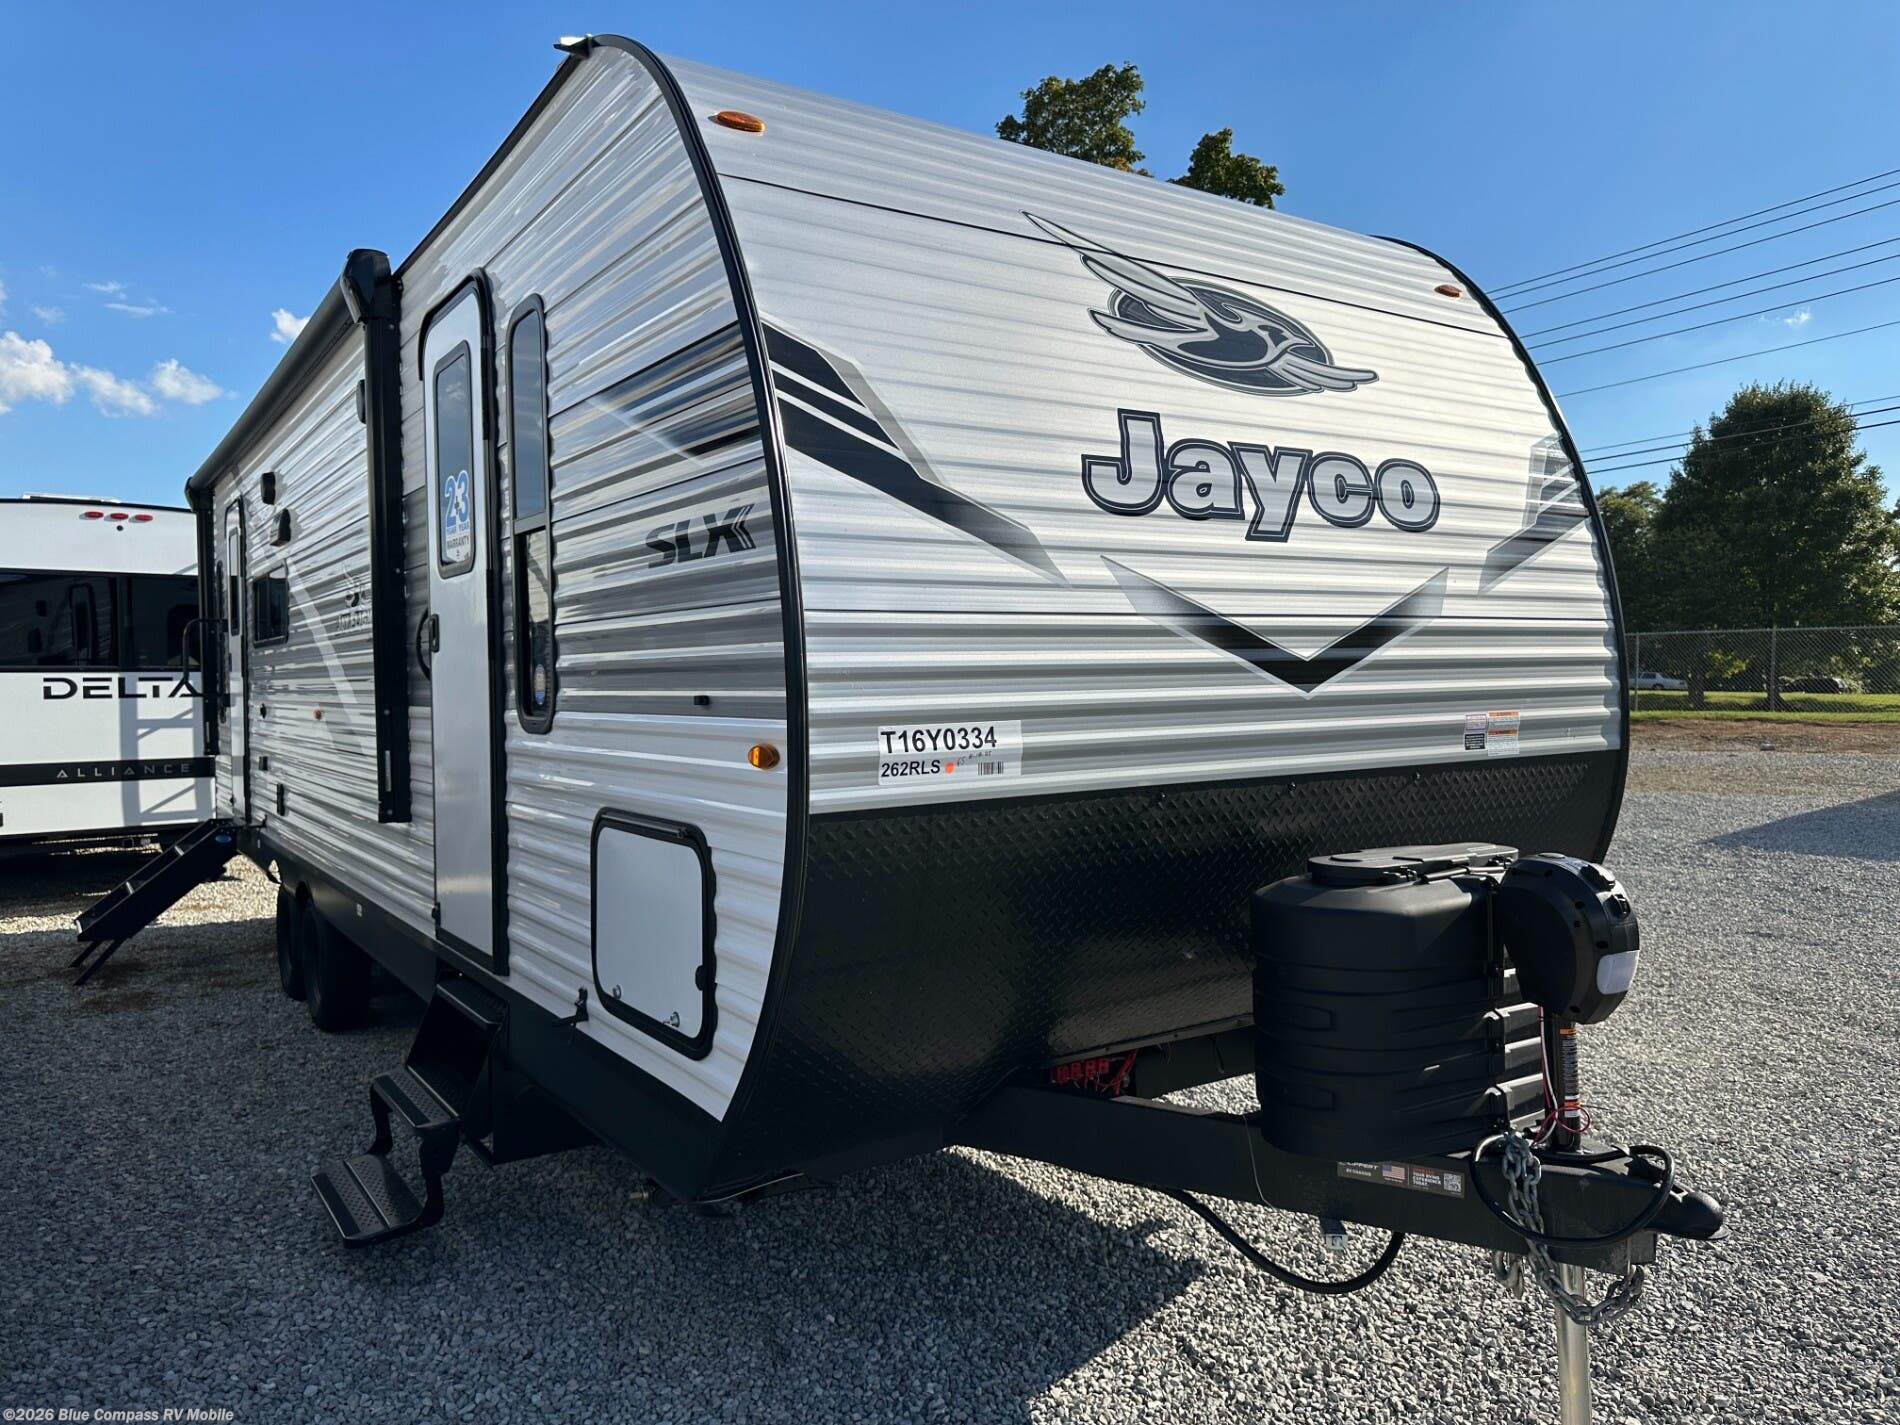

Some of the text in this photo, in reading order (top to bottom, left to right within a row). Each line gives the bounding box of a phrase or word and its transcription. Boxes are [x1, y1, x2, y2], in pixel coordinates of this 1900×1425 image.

[1081, 408, 1440, 542] Jayco
[446, 535, 470, 550] WARRANTY
[43, 677, 203, 699] DELTA
[881, 726, 997, 753] T16Y0334
[56, 763, 191, 779] ALLIANCE
[881, 760, 941, 777] 262RLS
